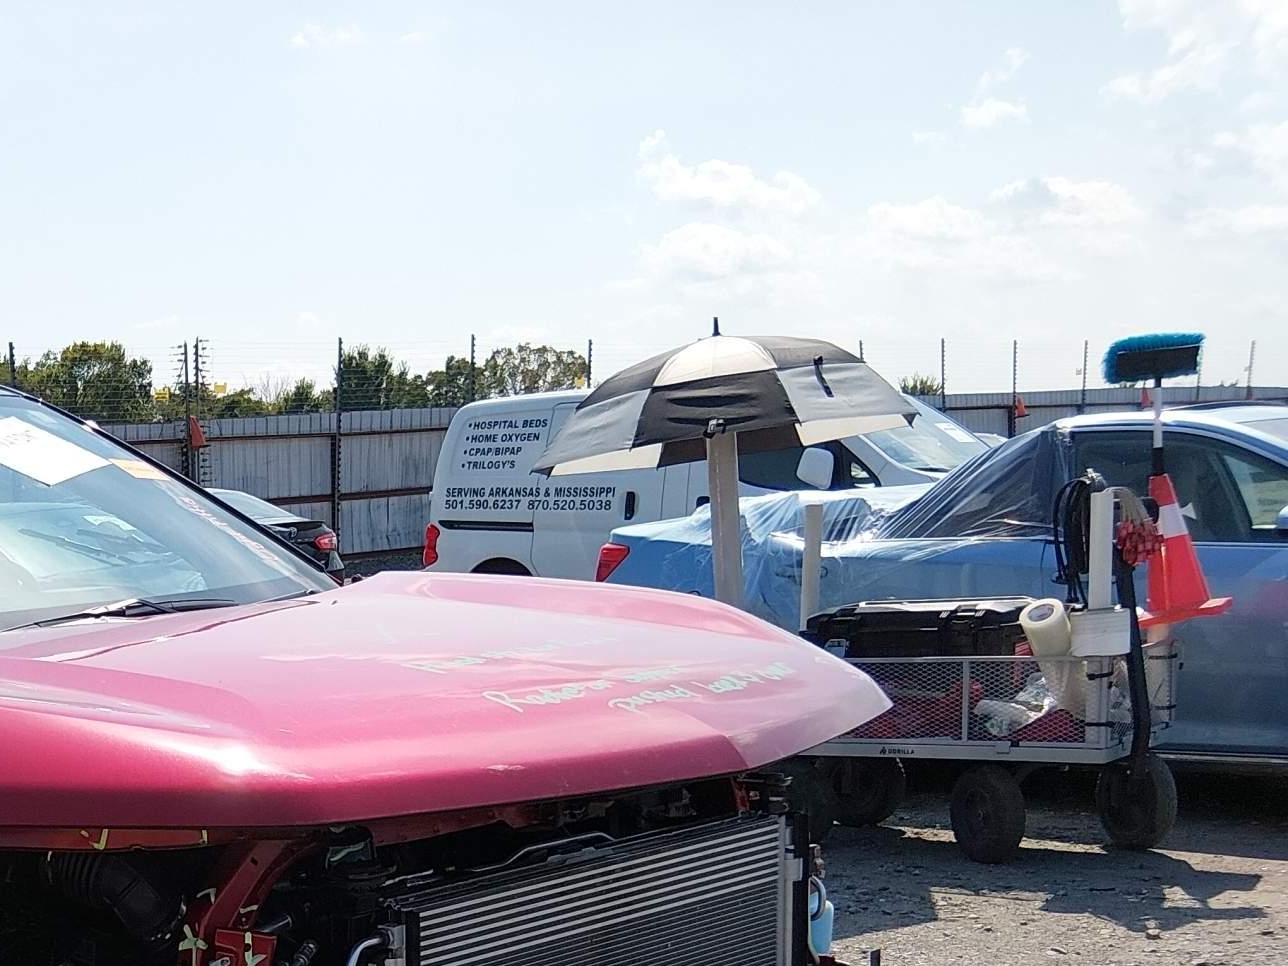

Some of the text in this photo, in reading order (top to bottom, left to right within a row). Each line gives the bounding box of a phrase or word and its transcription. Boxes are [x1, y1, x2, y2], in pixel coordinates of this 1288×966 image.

[472, 418, 548, 430] HOSPITAL BEDS
[470, 432, 540, 444] HOME OXYGEN
[466, 461, 516, 470] TRILOGY'S
[446, 486, 616, 498] SERVING ARKANSAS & MISSISSIPPI
[444, 499, 612, 511] 501.590.6237 870.520.5038
